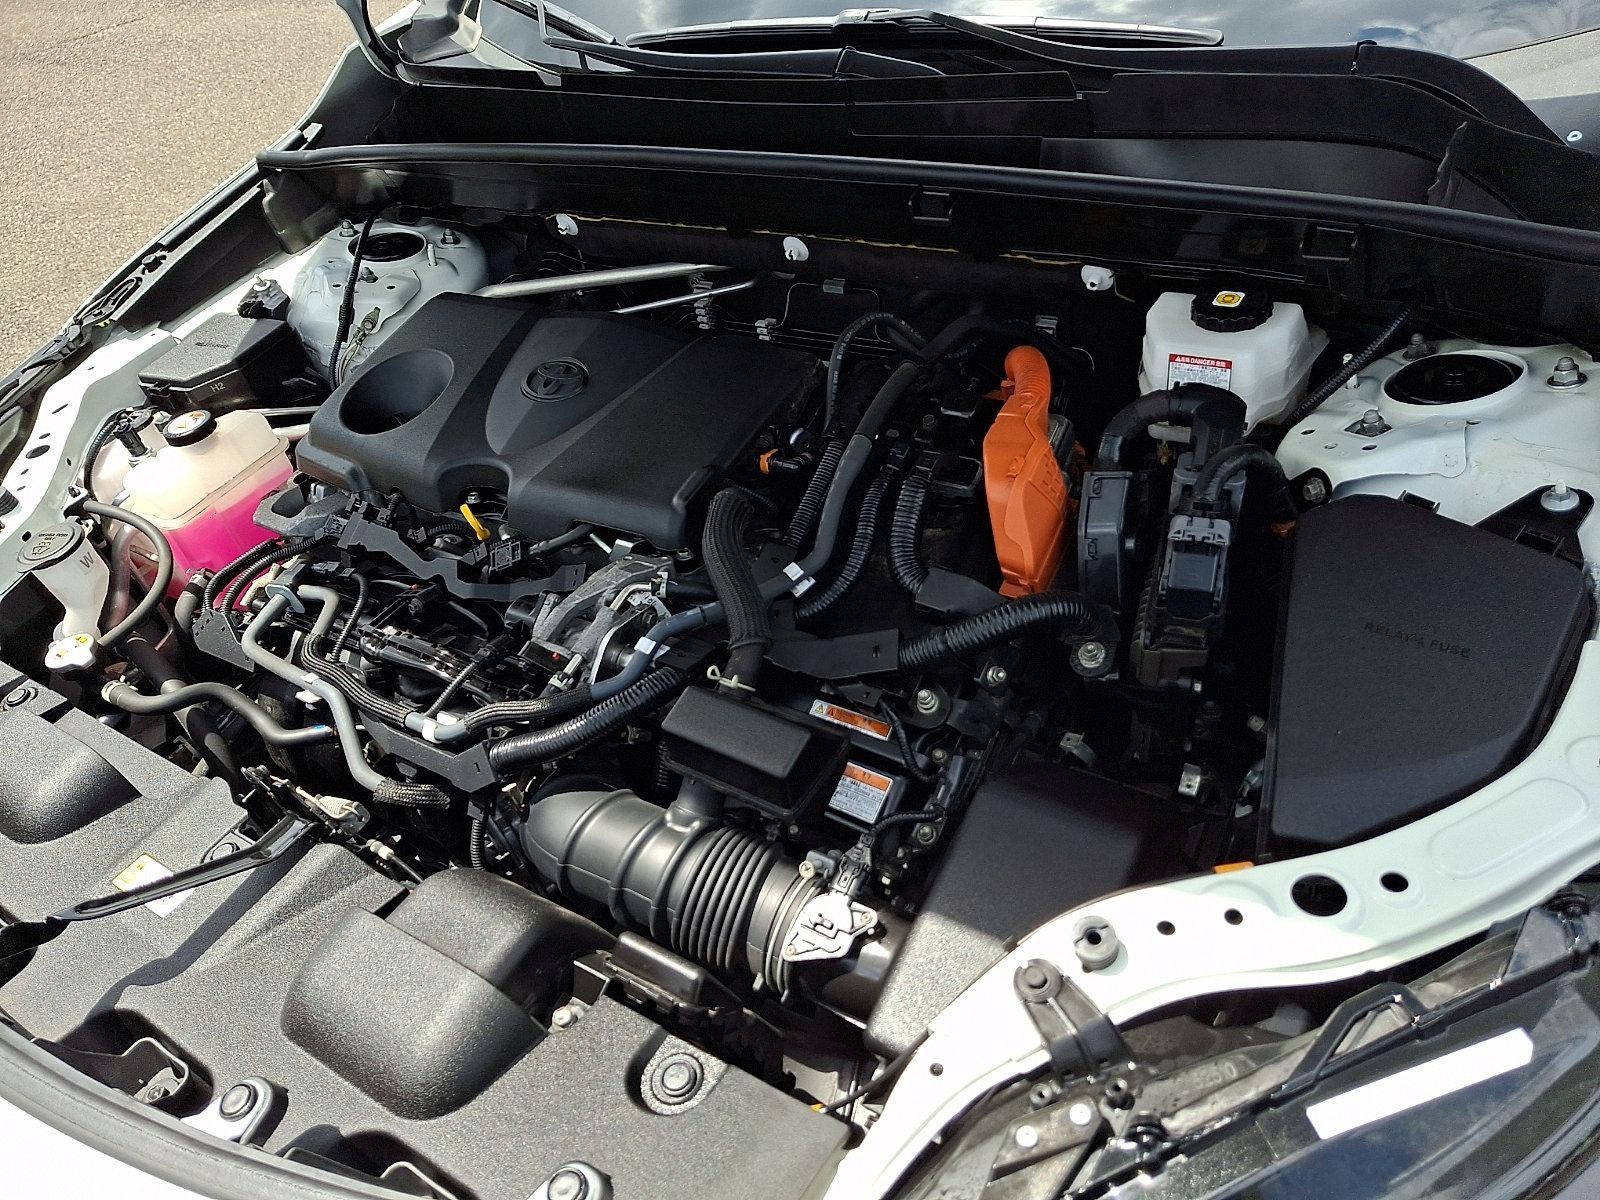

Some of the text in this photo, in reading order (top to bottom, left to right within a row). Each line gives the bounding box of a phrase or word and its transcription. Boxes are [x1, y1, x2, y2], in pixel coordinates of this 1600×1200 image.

[1190, 357, 1216, 366] DANGER
[210, 382, 226, 392] H2
[1364, 622, 1416, 642] RELAY
[1429, 639, 1472, 659] FUSE
